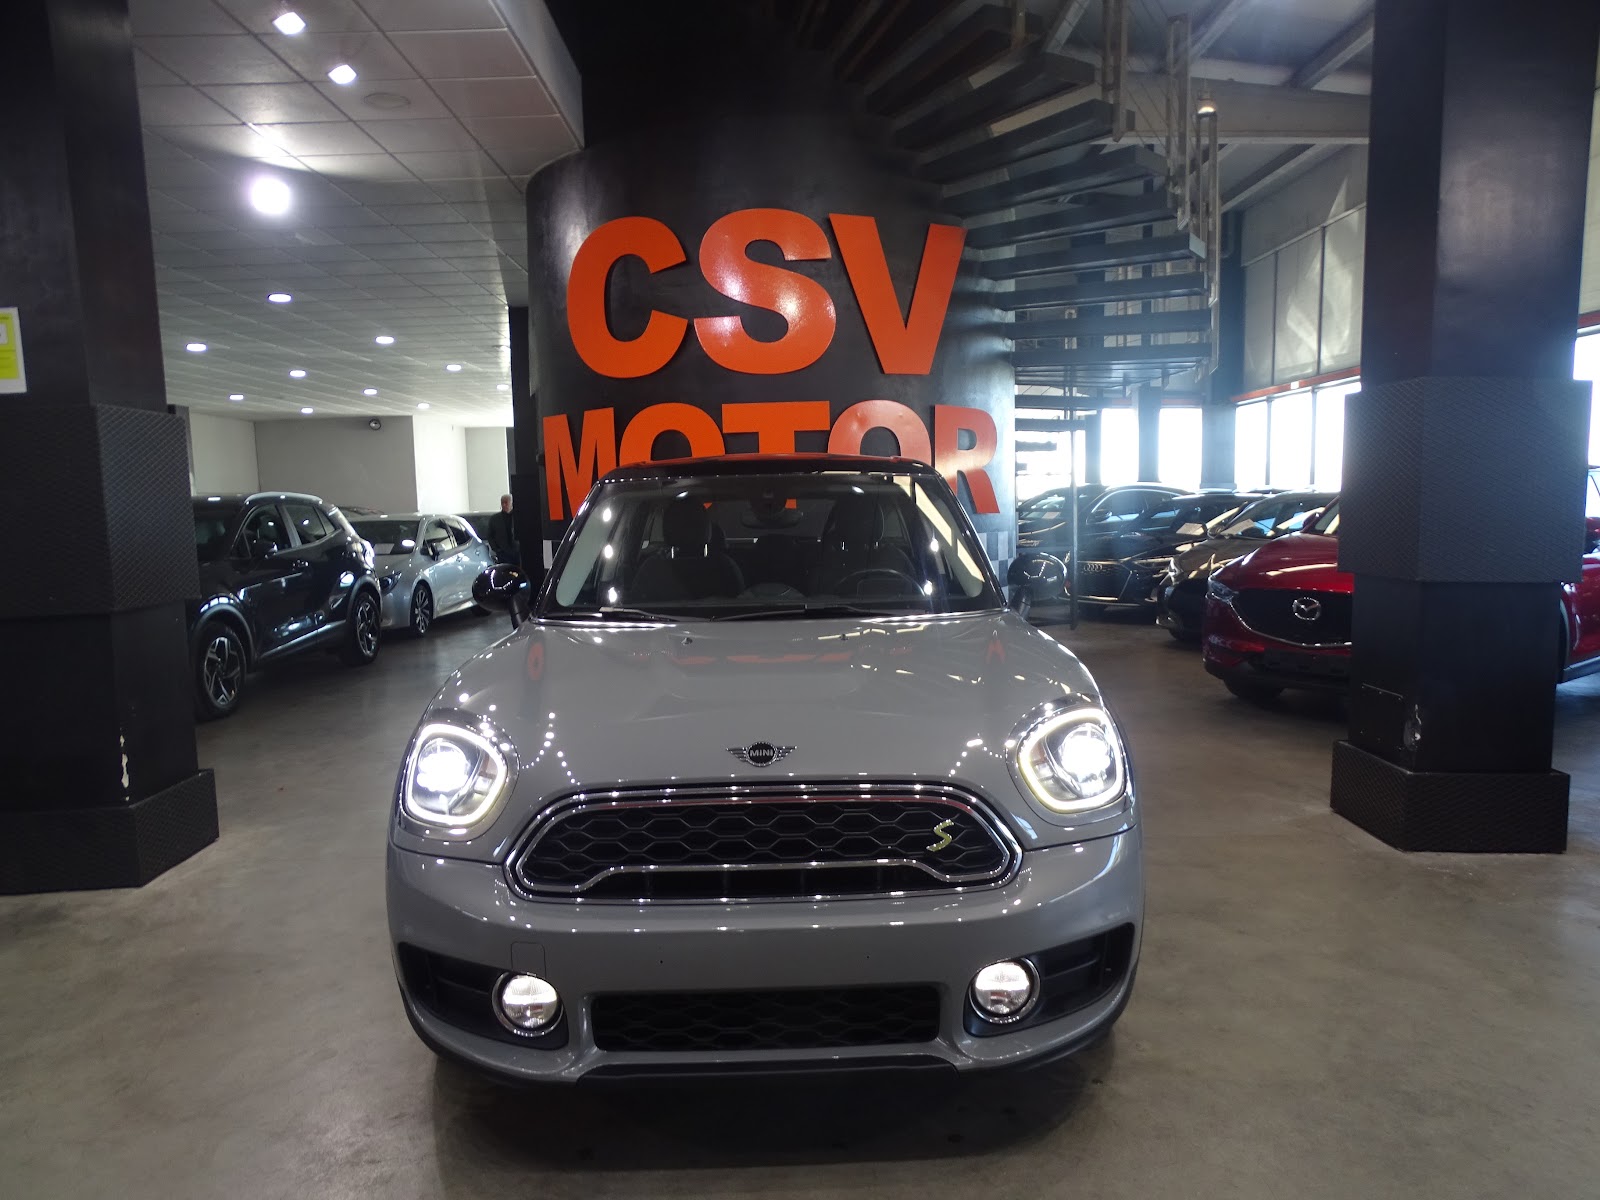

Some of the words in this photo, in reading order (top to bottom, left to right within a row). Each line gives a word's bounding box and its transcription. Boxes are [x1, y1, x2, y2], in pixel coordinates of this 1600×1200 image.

[566, 208, 967, 378] CSV
[749, 747, 774, 758] MINI
[926, 819, 955, 852] S
